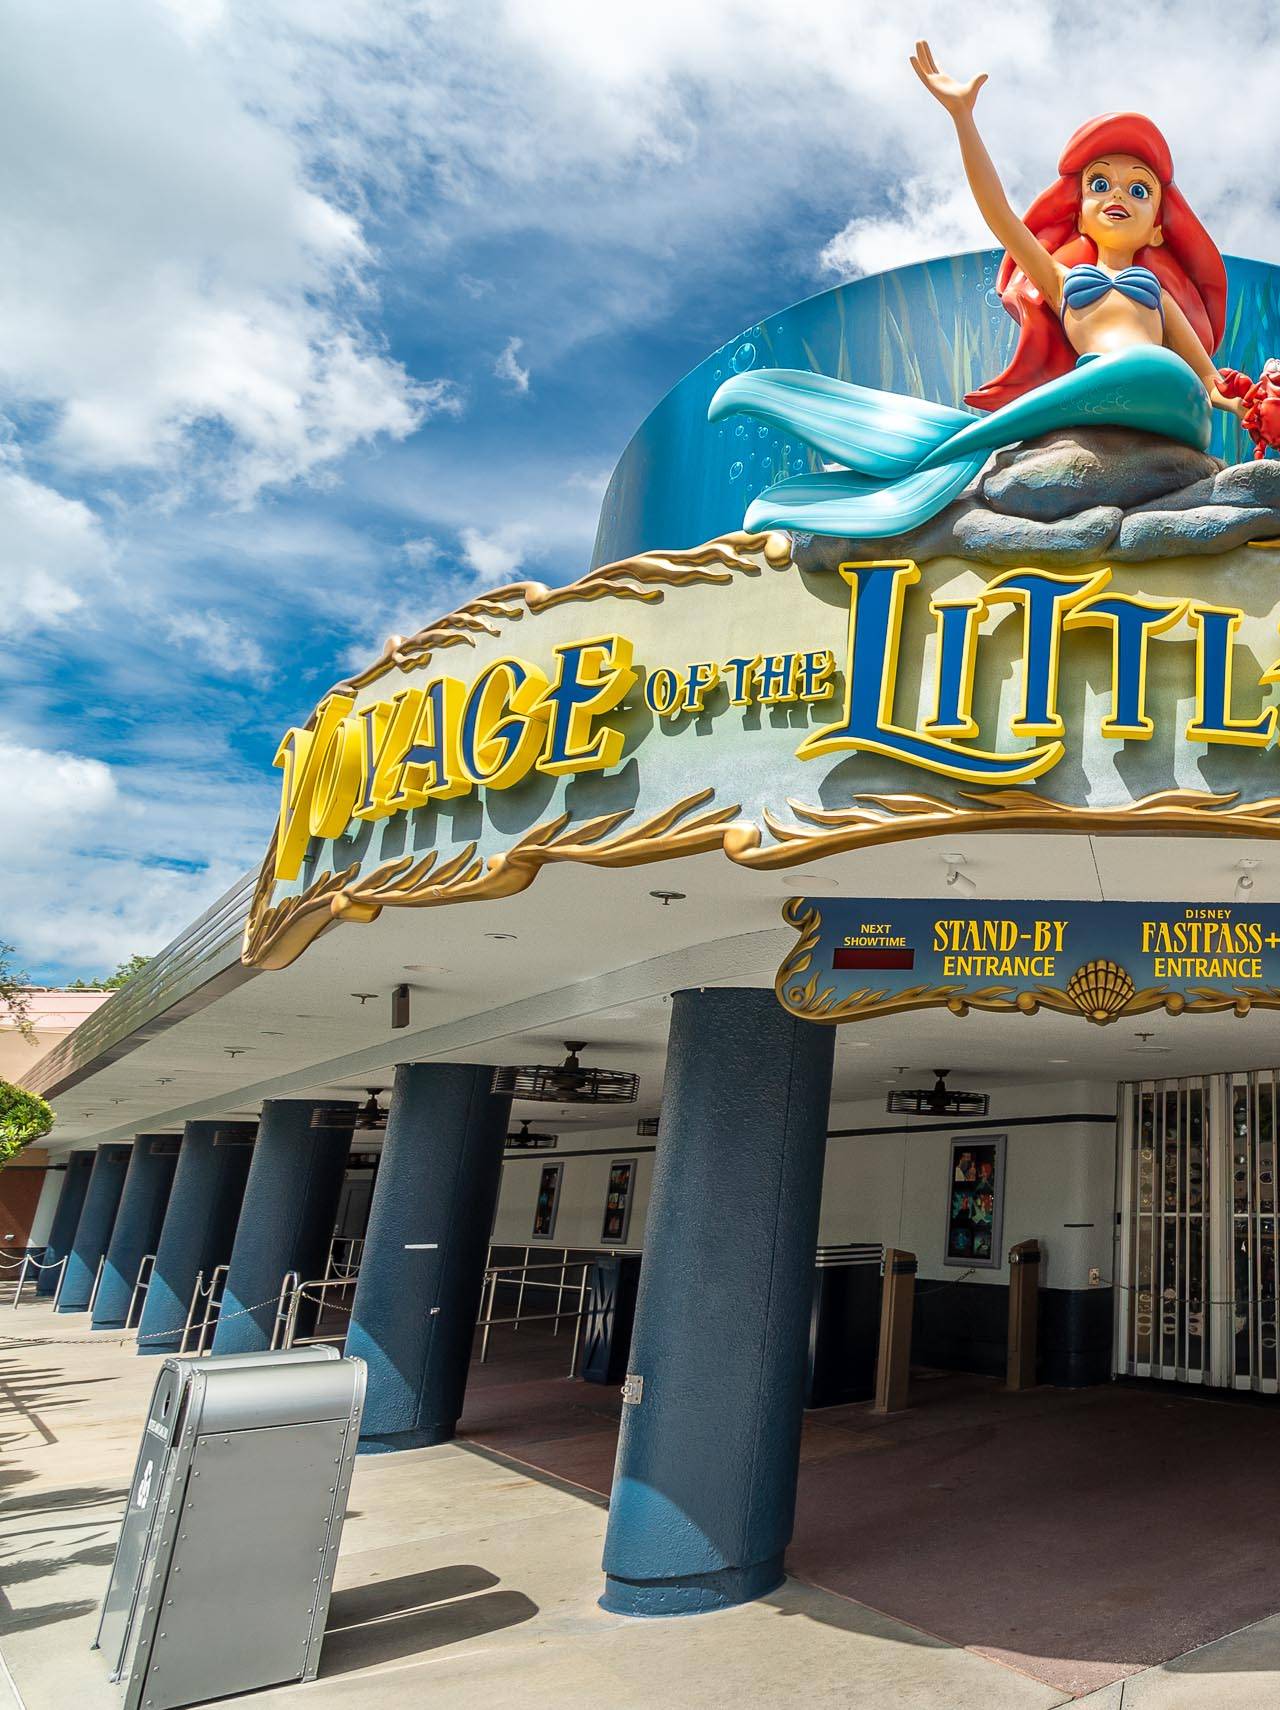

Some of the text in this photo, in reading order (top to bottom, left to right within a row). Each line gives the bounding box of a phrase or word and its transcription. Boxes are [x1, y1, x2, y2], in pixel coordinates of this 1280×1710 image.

[272, 633, 633, 880] VOYAGE
[644, 661, 719, 716] OF
[723, 649, 835, 706] THE
[1185, 909, 1232, 919] DISNEY
[860, 924, 892, 935] NEXT
[933, 920, 1069, 952] STAND-BY
[843, 936, 907, 948] SHOWTIME
[943, 955, 1056, 977] ENTRANCE
[1154, 957, 1262, 978] ENTRANCE
